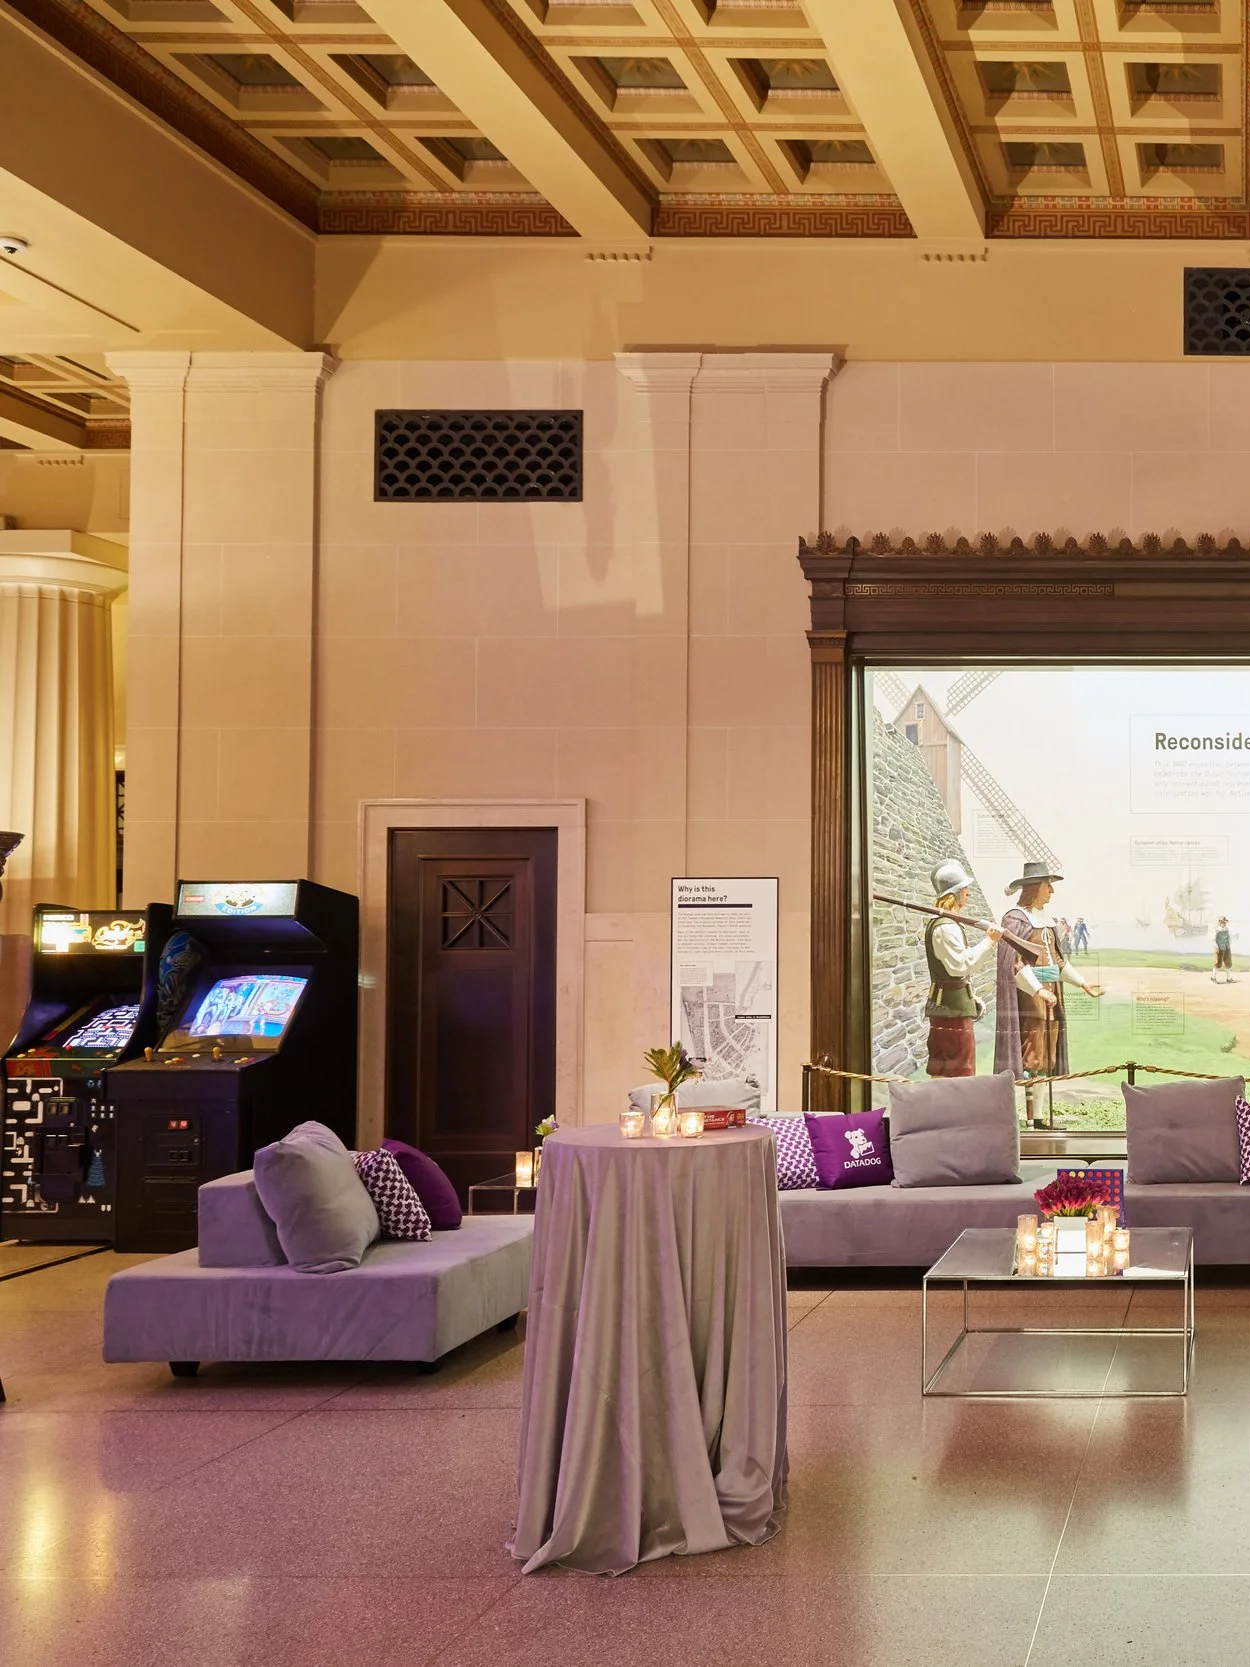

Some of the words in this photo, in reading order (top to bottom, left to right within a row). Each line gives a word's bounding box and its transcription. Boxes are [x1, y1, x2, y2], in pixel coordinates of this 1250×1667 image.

[678, 885, 693, 893] Why
[221, 903, 258, 915] EDITION
[844, 1157, 881, 1169] DATADOG
